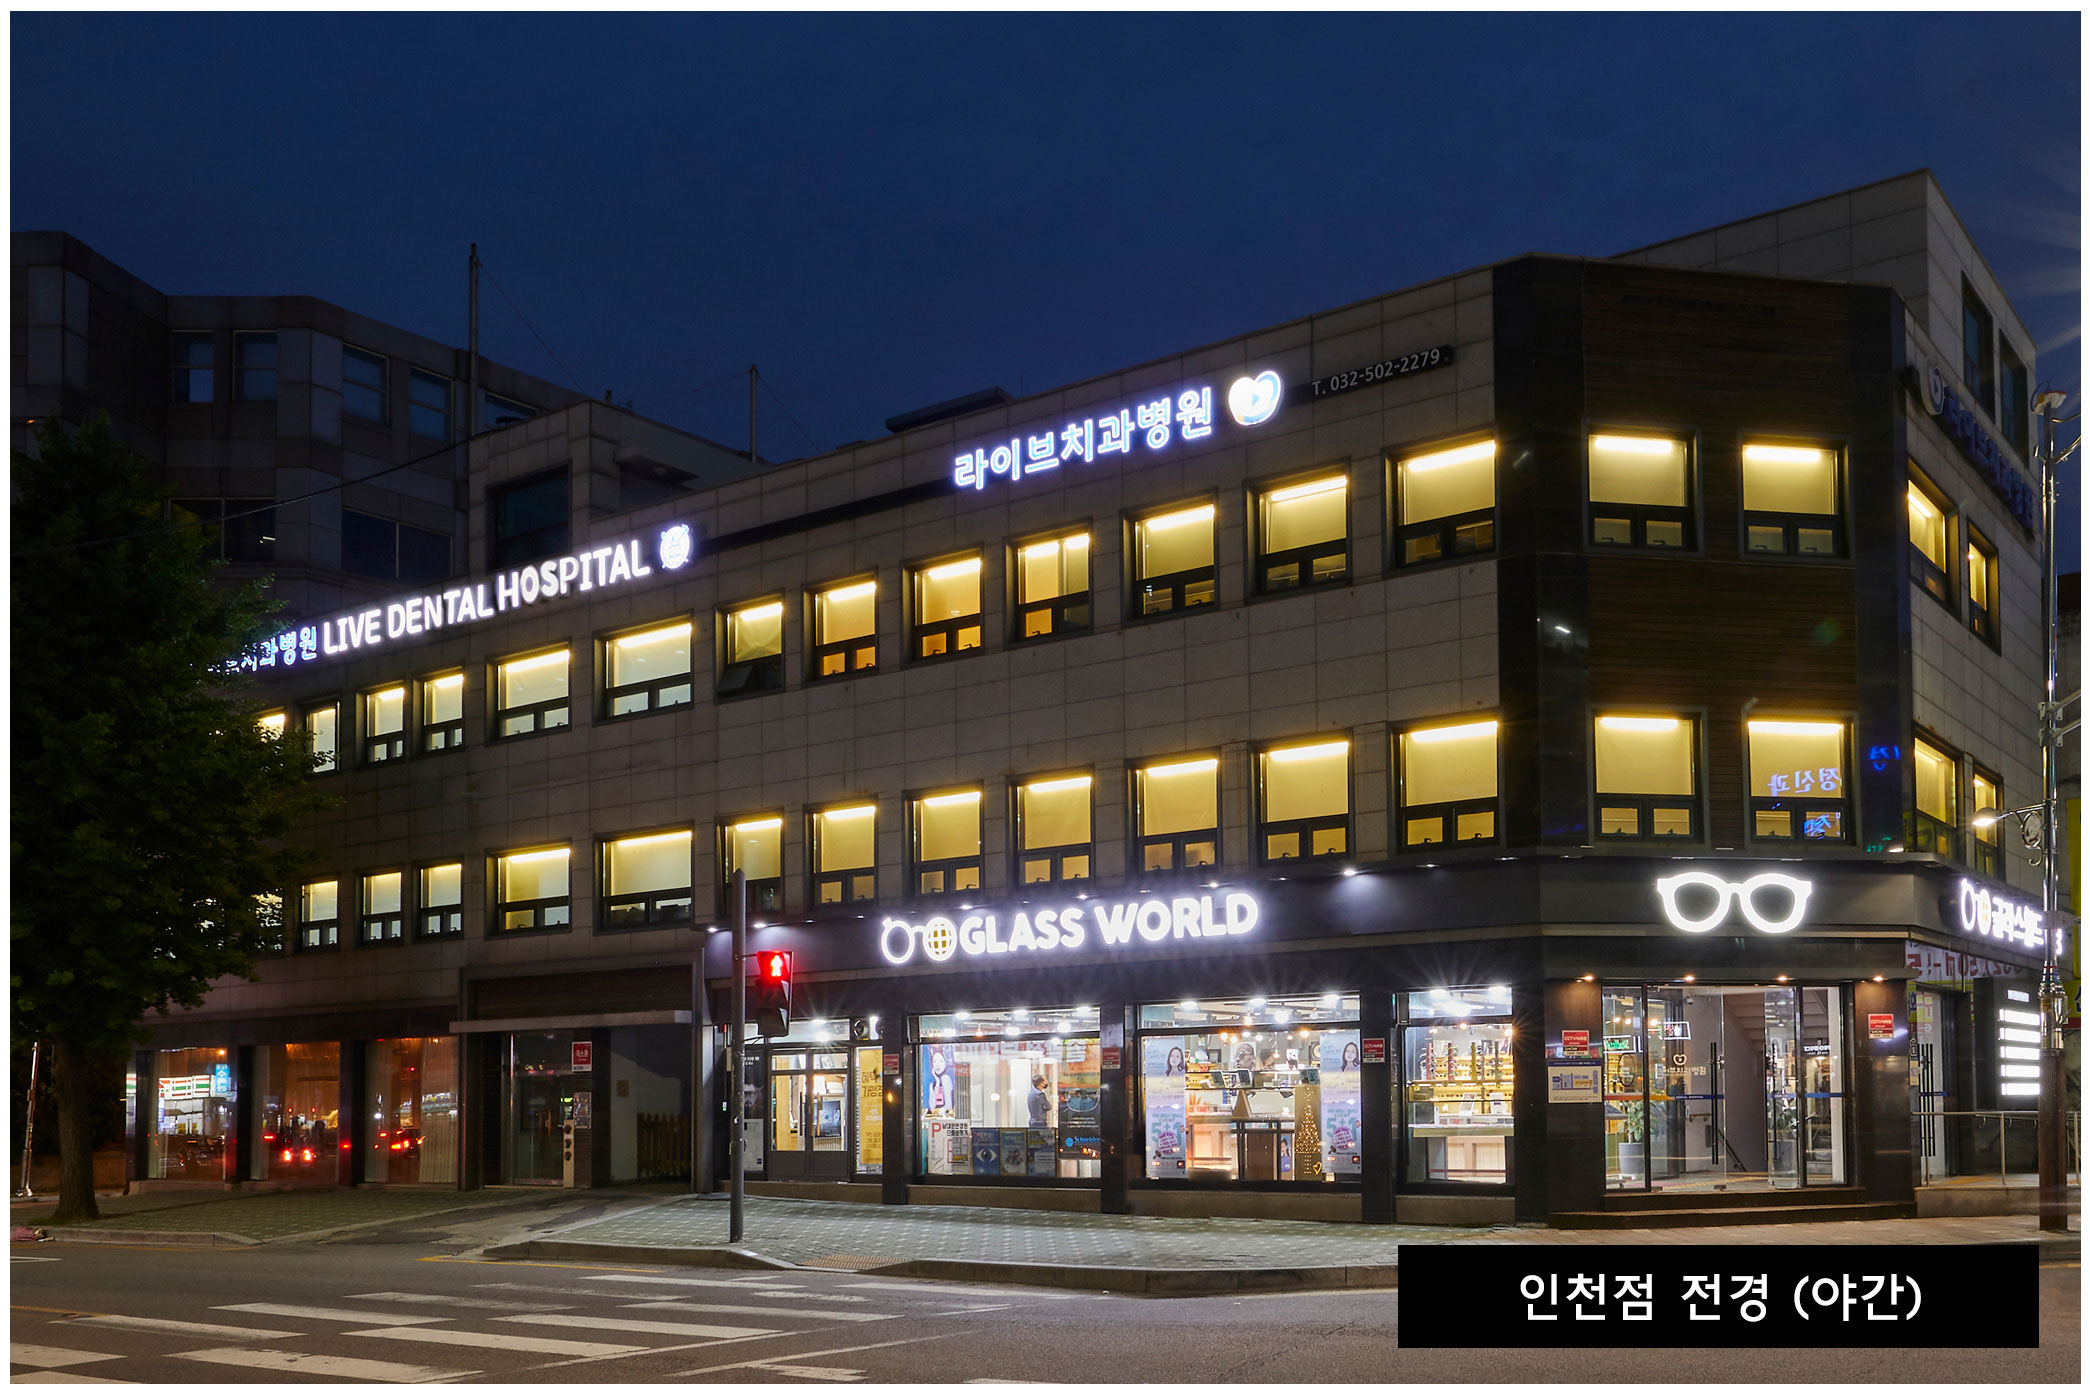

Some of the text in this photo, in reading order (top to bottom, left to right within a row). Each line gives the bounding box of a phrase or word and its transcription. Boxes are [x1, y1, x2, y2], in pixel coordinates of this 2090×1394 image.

[1311, 348, 1441, 396] T. 032-502-2279
[954, 386, 1212, 489] 라이브치과병원
[322, 540, 650, 654] LIVE DENTAL HOSPITAL
[959, 893, 1259, 955] GLASS WORLD
